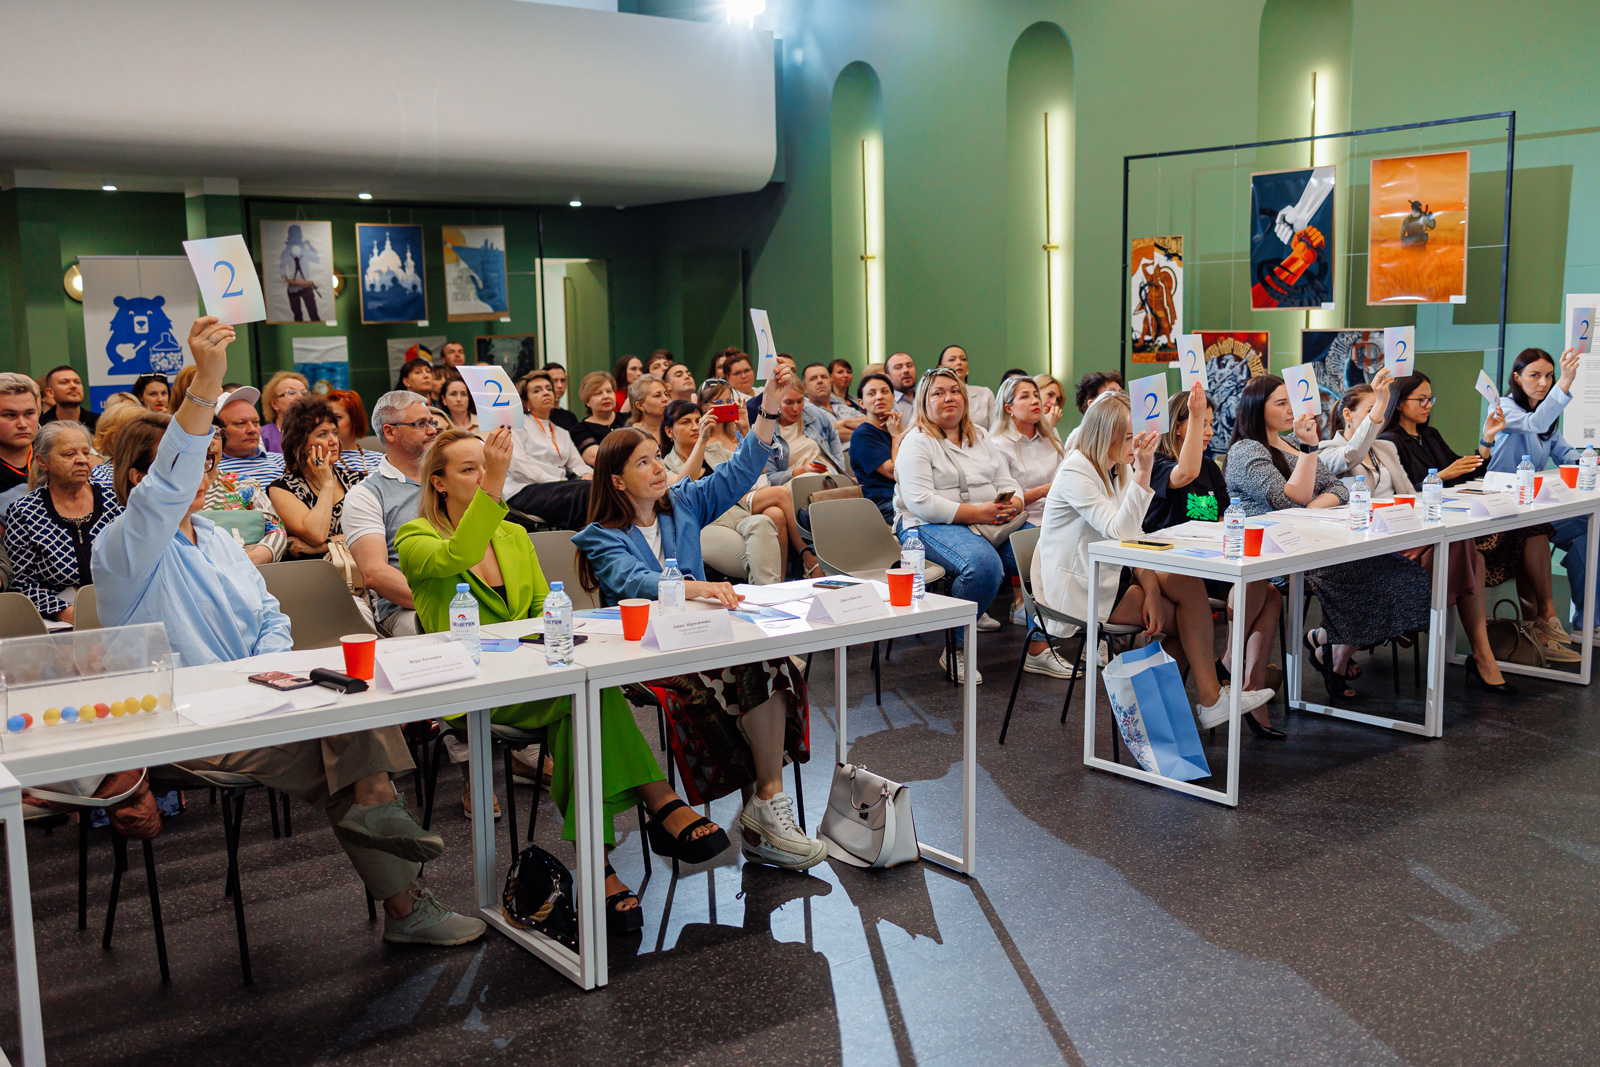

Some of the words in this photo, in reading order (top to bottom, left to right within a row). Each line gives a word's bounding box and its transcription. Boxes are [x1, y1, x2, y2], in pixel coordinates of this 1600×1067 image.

[213, 260, 244, 299] 2
[760, 328, 774, 358] 2
[1579, 319, 1590, 341] 2
[1186, 349, 1200, 374] 2
[1395, 340, 1408, 363] 2
[484, 379, 510, 407] 2
[1297, 378, 1314, 402] 2
[1143, 392, 1161, 421] 2
